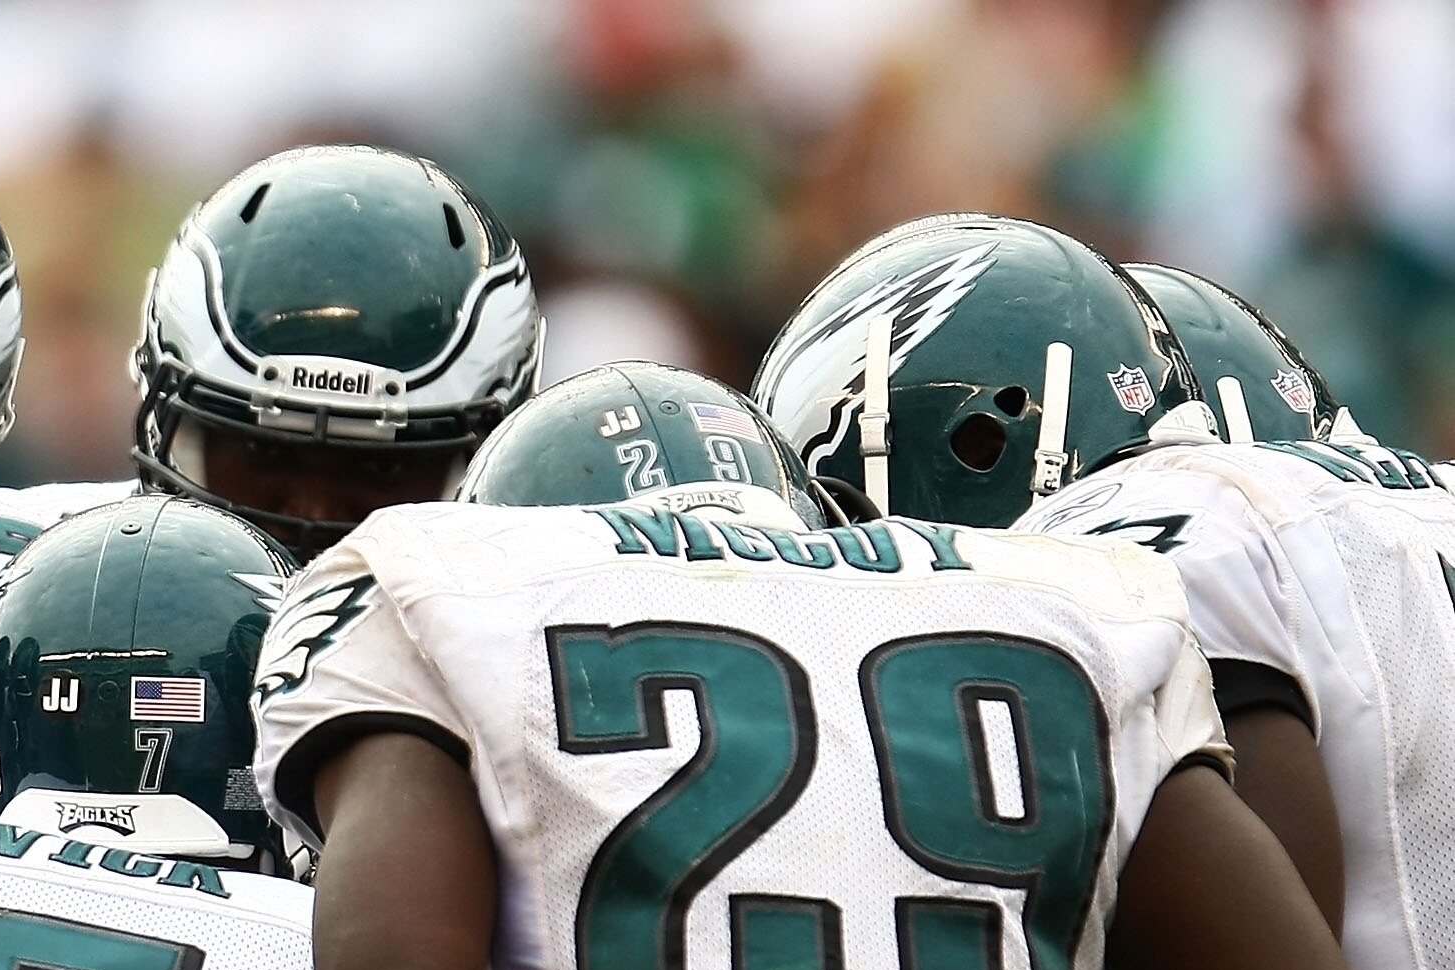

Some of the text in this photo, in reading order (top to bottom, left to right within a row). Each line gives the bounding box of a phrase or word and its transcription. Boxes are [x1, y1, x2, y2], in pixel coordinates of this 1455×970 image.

[292, 366, 371, 395] Riddell
[1122, 387, 1151, 406] NFL
[600, 404, 642, 437] JJ
[657, 490, 746, 514] EAGLES
[43, 677, 80, 712] JJ
[135, 727, 173, 793] 7
[54, 801, 140, 837] EAGLES
